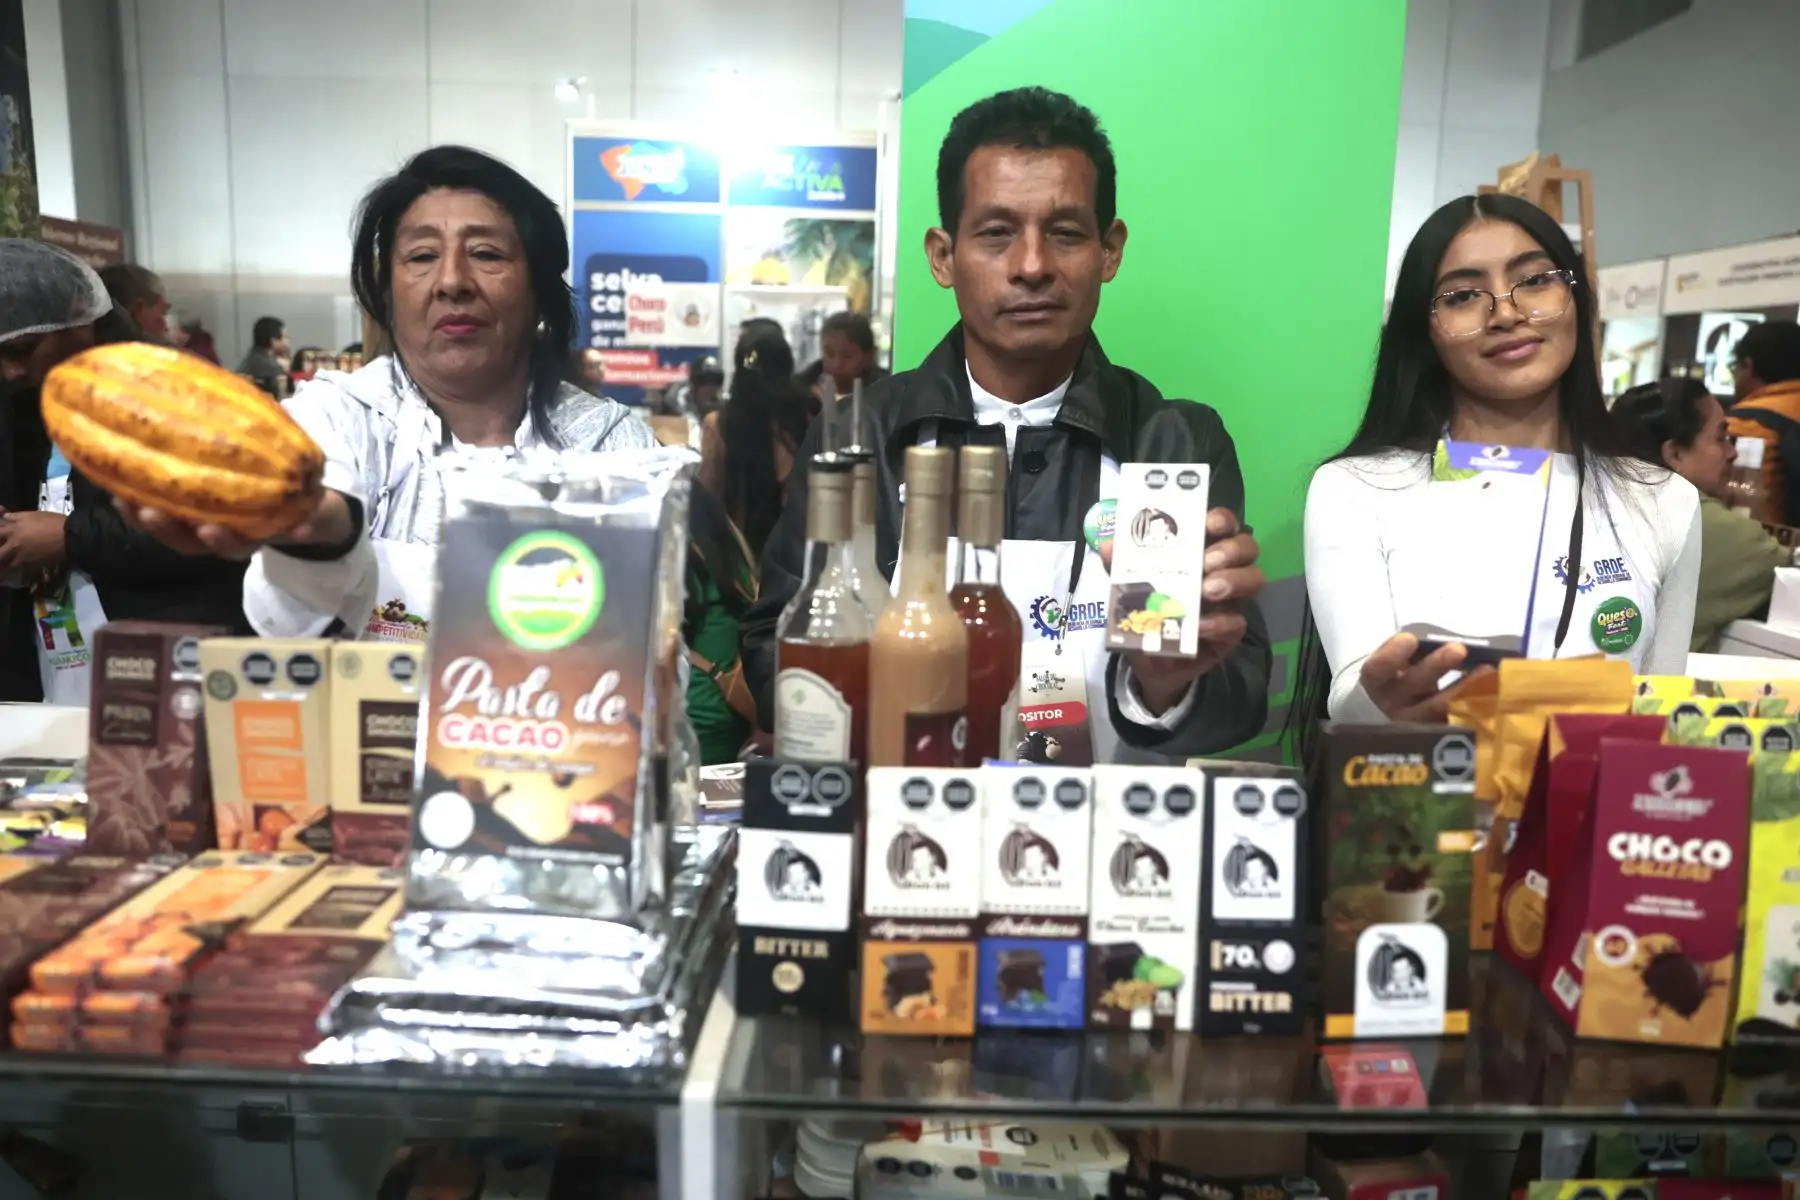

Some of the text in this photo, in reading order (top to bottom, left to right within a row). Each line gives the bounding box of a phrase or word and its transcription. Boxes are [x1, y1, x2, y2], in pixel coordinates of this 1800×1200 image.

[1593, 557, 1627, 575] GRDE
[1069, 601, 1106, 622] GRDE
[441, 656, 628, 725] Pasta de
[443, 720, 564, 750] CACAO
[1343, 755, 1429, 788] Cacao
[1607, 832, 1733, 869] CHOCO
[754, 936, 829, 959] BITTER
[1209, 990, 1293, 1015] BITTER
